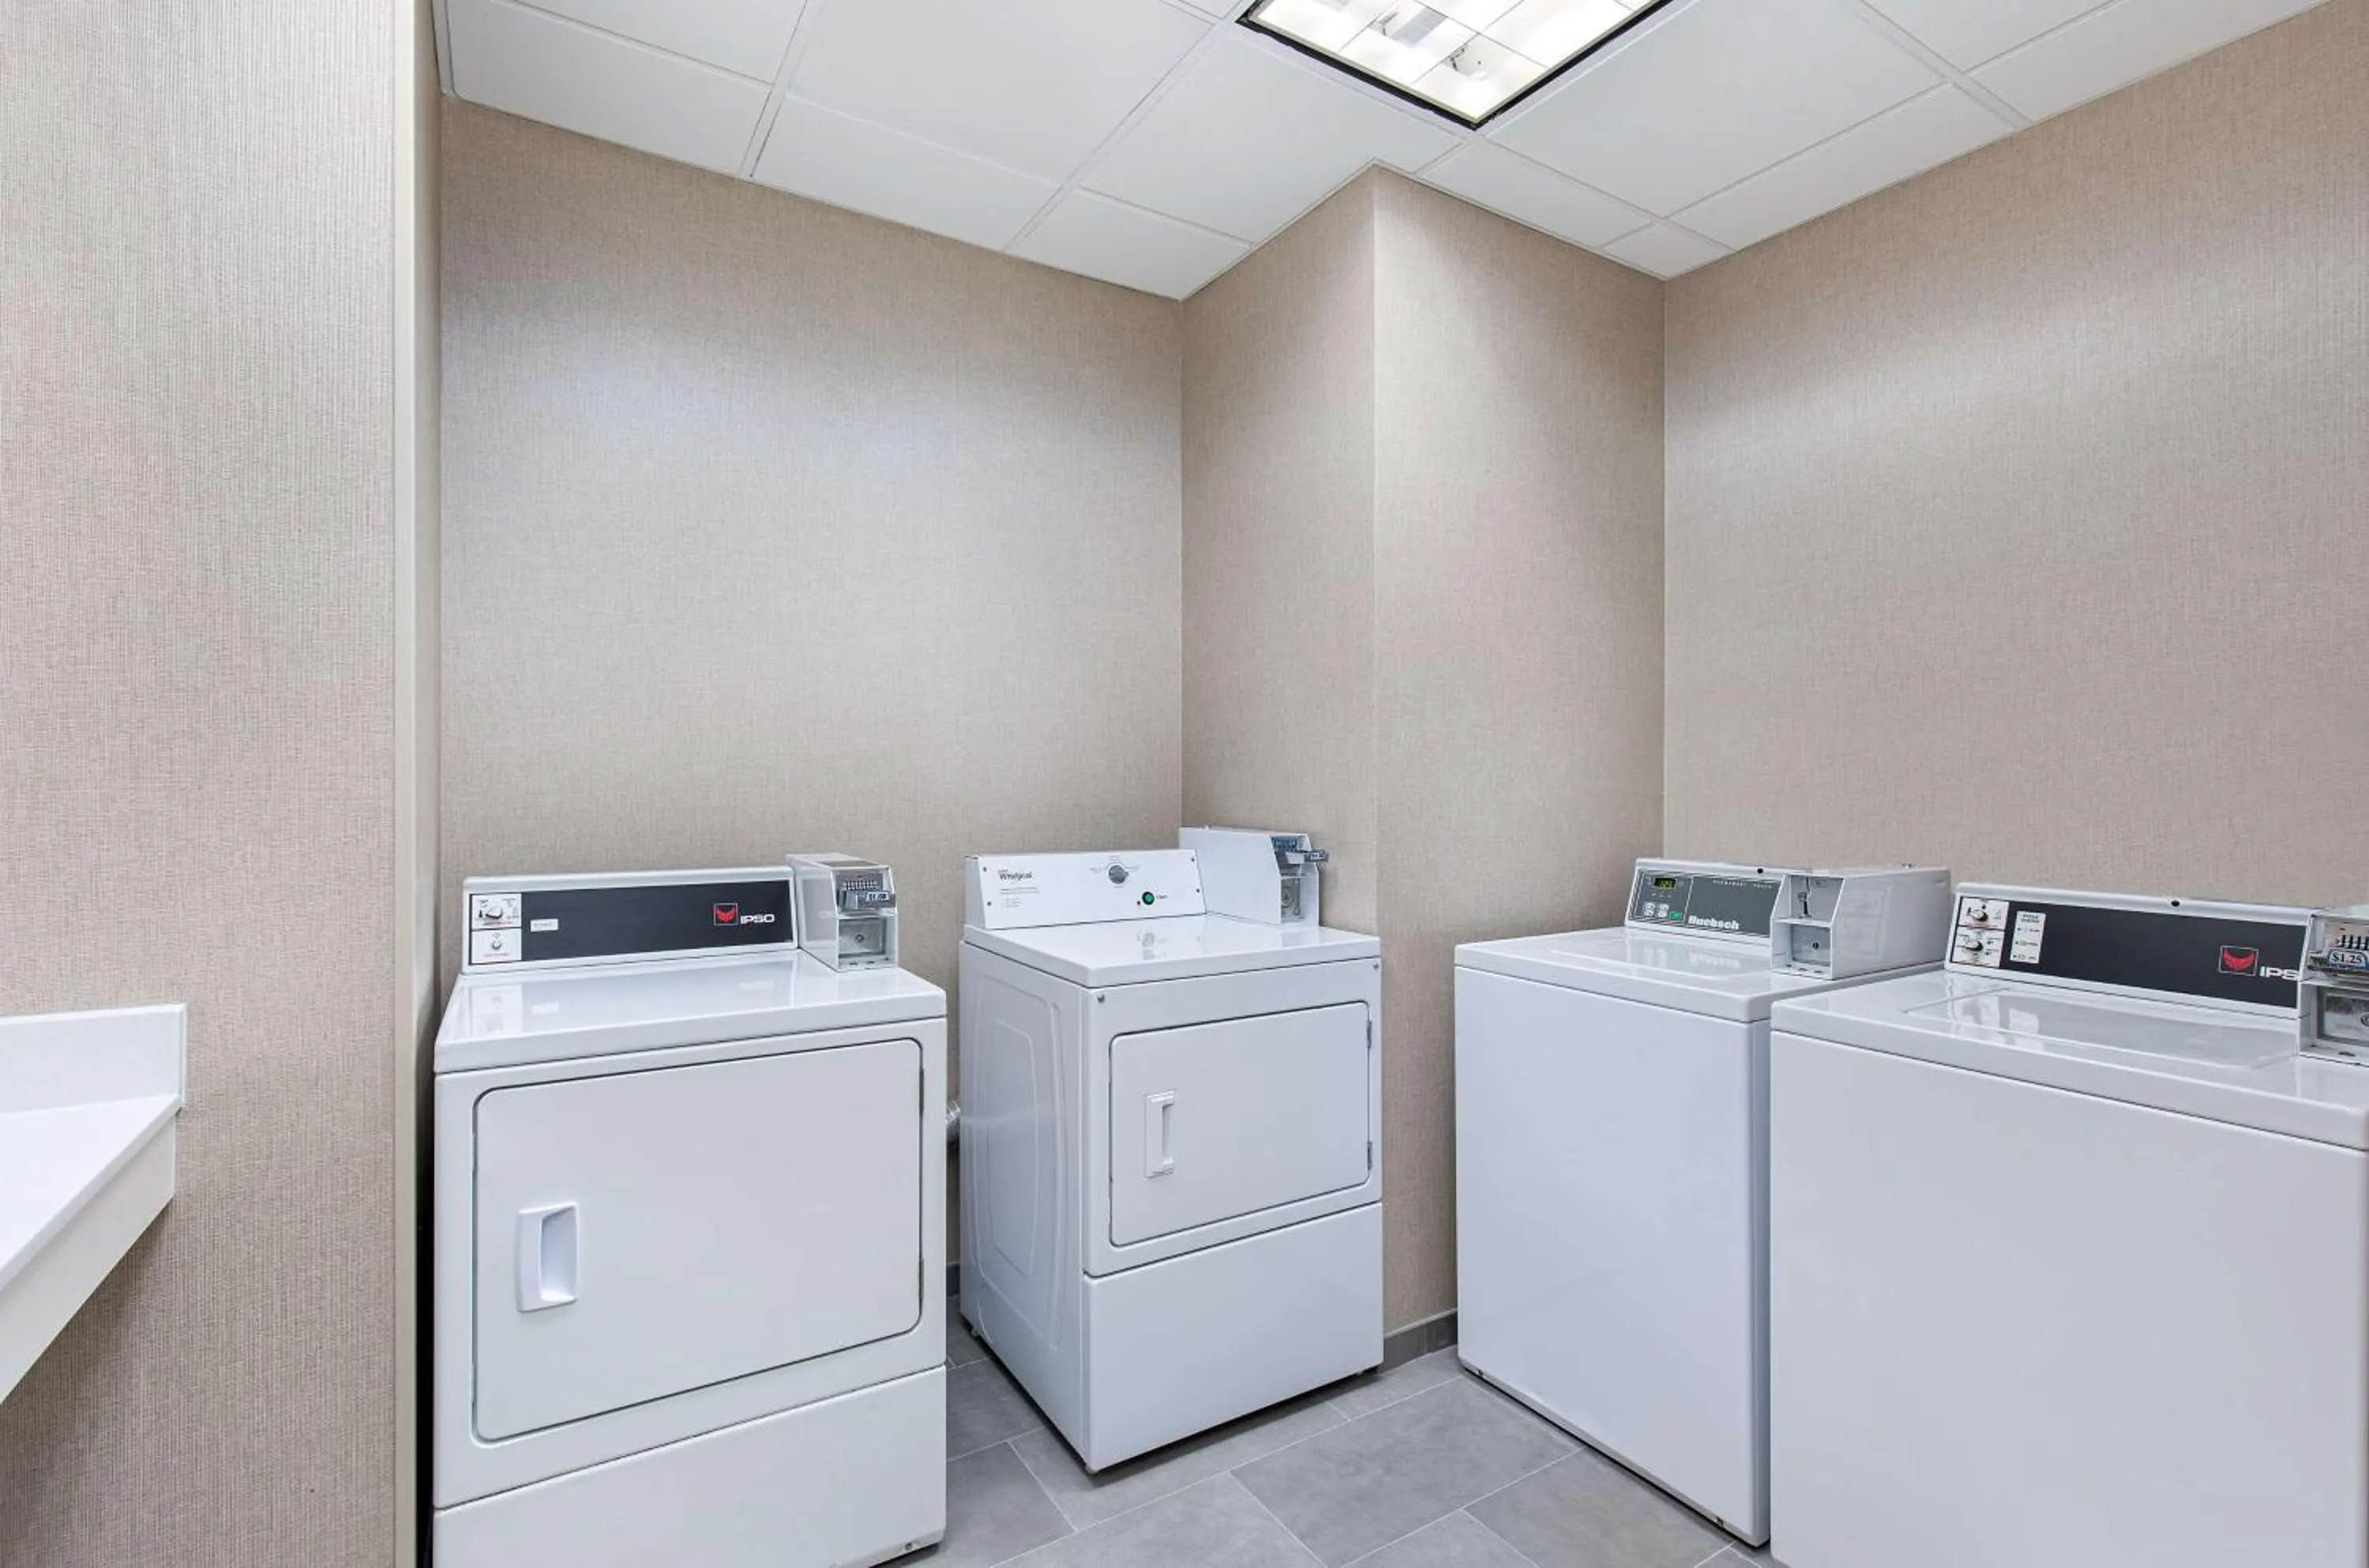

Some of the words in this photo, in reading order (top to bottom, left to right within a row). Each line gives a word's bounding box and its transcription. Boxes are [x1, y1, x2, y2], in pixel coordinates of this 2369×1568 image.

[740, 913, 775, 925] IPSO
[1688, 915, 1740, 930] Huebsch
[2332, 952, 2363, 964] $1.25
